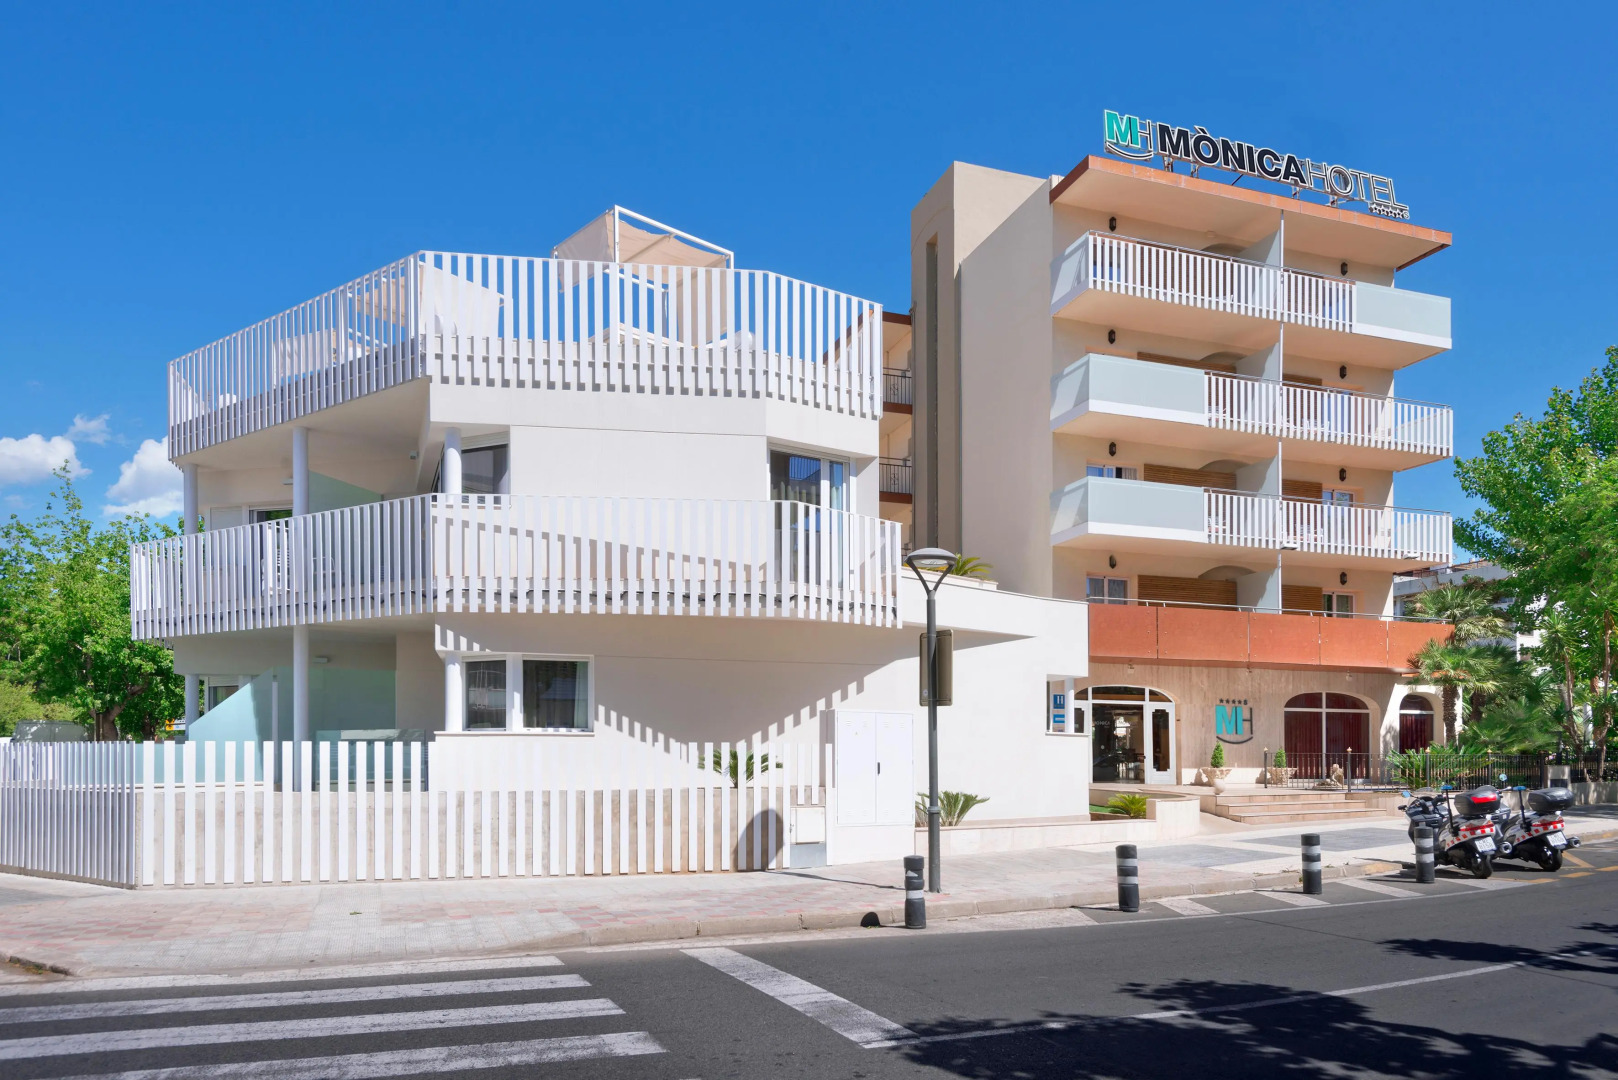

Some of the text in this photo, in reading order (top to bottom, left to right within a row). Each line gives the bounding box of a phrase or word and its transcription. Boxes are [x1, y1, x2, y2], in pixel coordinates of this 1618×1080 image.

[1156, 121, 1308, 188] MÒNICA
[1306, 158, 1410, 210] HOTEL
[1215, 705, 1253, 735] MH
